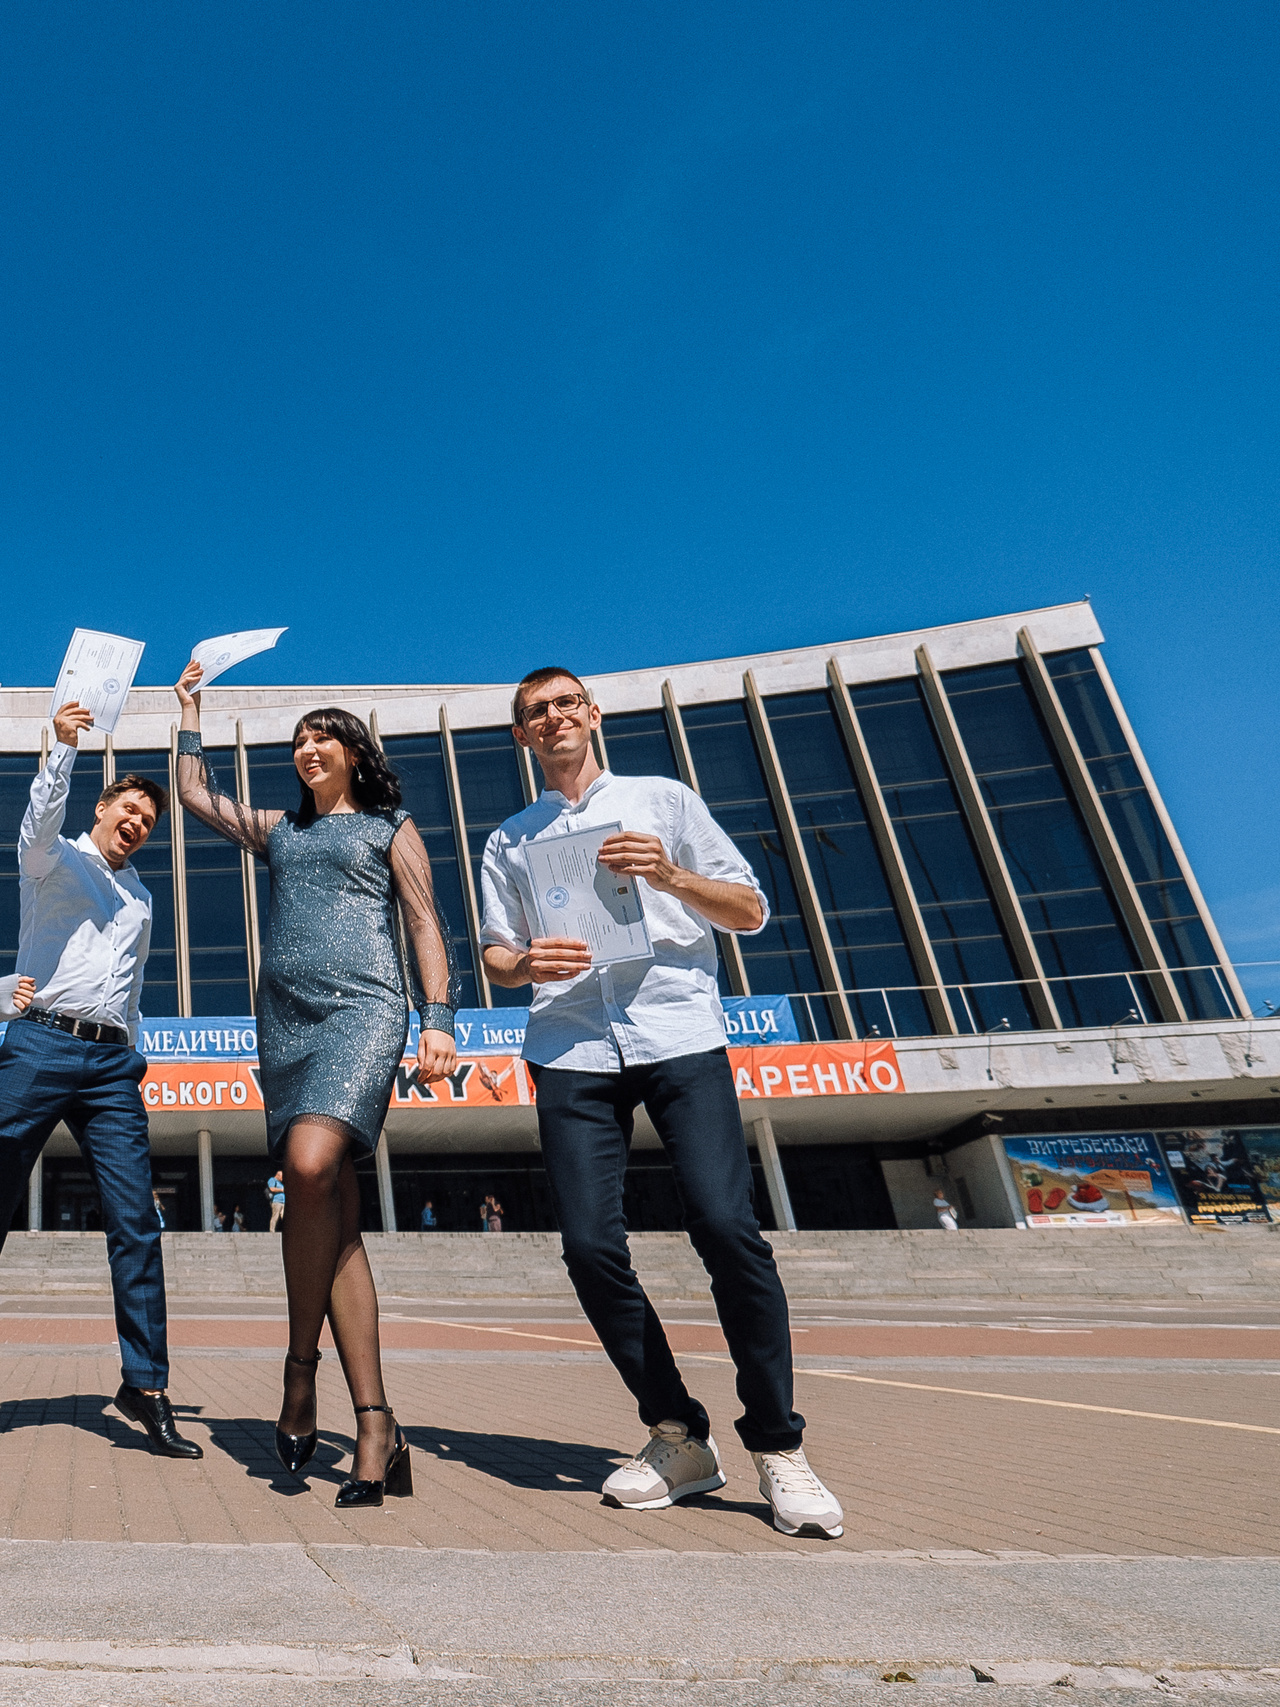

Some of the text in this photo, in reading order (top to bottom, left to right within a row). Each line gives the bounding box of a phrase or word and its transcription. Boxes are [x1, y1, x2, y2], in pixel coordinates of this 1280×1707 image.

[142, 1029, 257, 1057] МЕДИЧНО
[723, 1009, 779, 1036] ЬЦЯ
[138, 1081, 247, 1106] СЬКОГО
[735, 1060, 899, 1097] АРЕНКО
